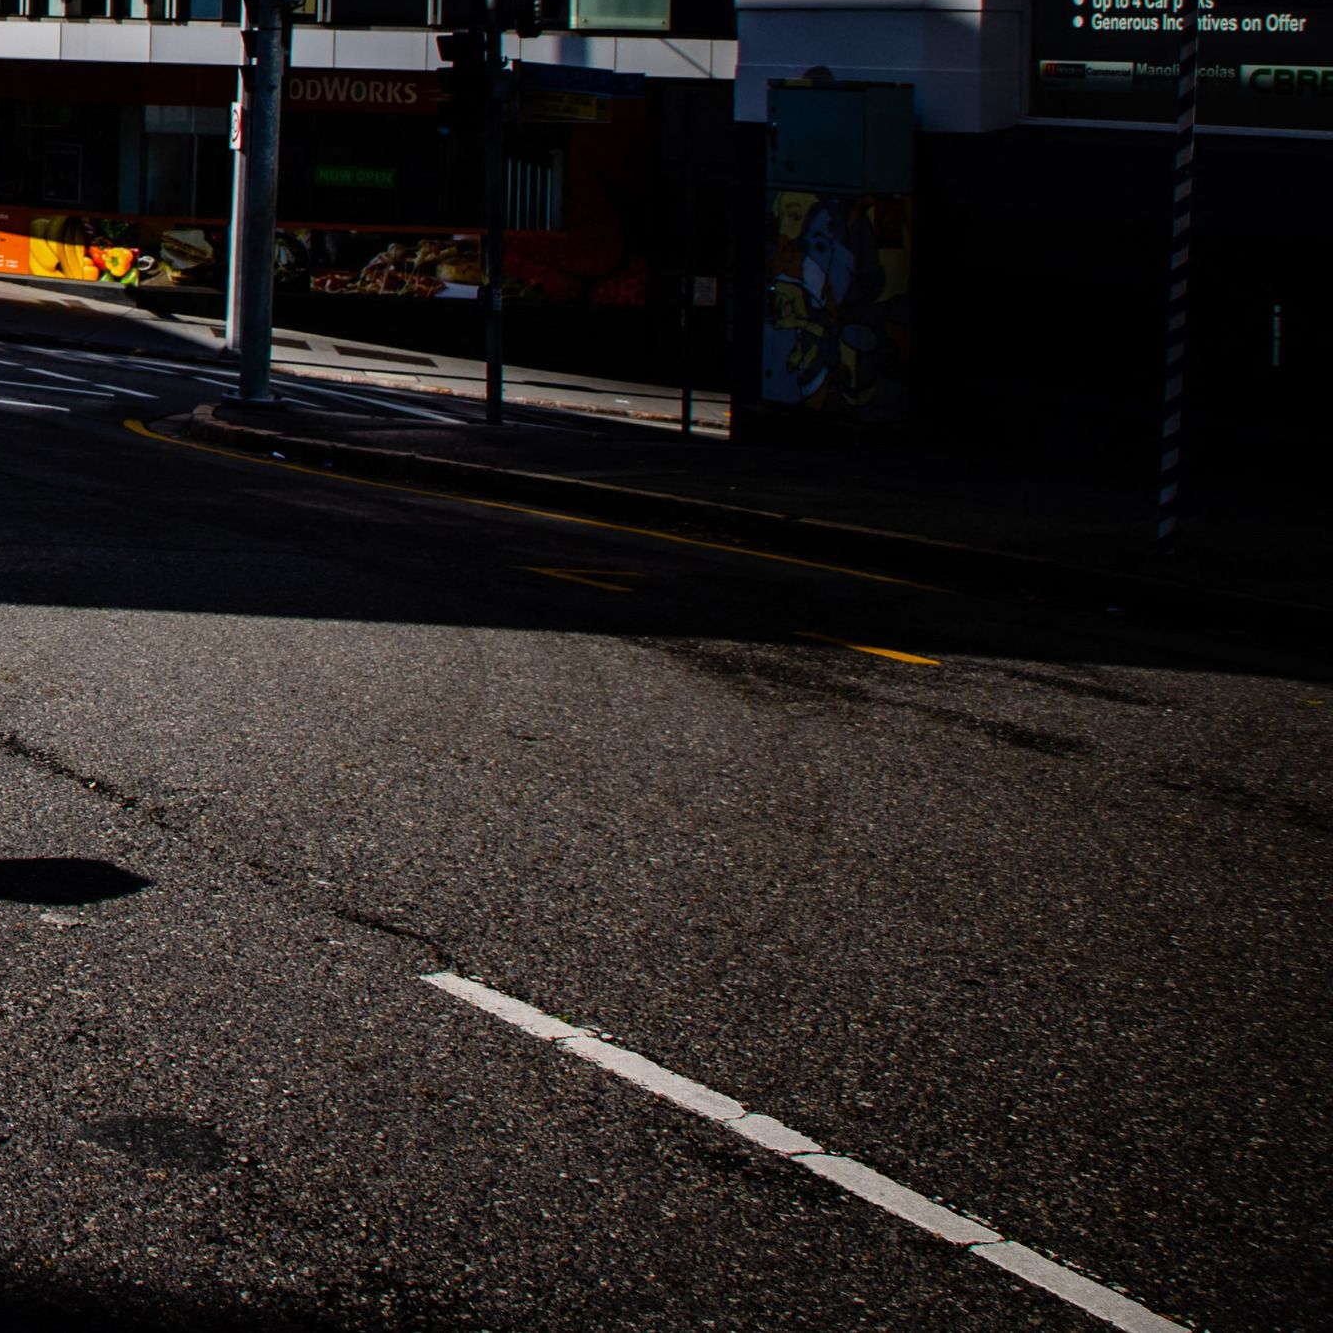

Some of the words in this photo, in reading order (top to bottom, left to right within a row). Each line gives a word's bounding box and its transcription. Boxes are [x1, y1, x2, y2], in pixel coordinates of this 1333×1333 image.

[1091, 14, 1158, 30] Generous
[1162, 13, 1238, 31] Inctives
[1242, 17, 1261, 31] on
[1266, 13, 1307, 32] Offer
[288, 76, 419, 104] ODWORKS
[318, 170, 352, 181] NOW
[356, 171, 393, 182] OPEN
